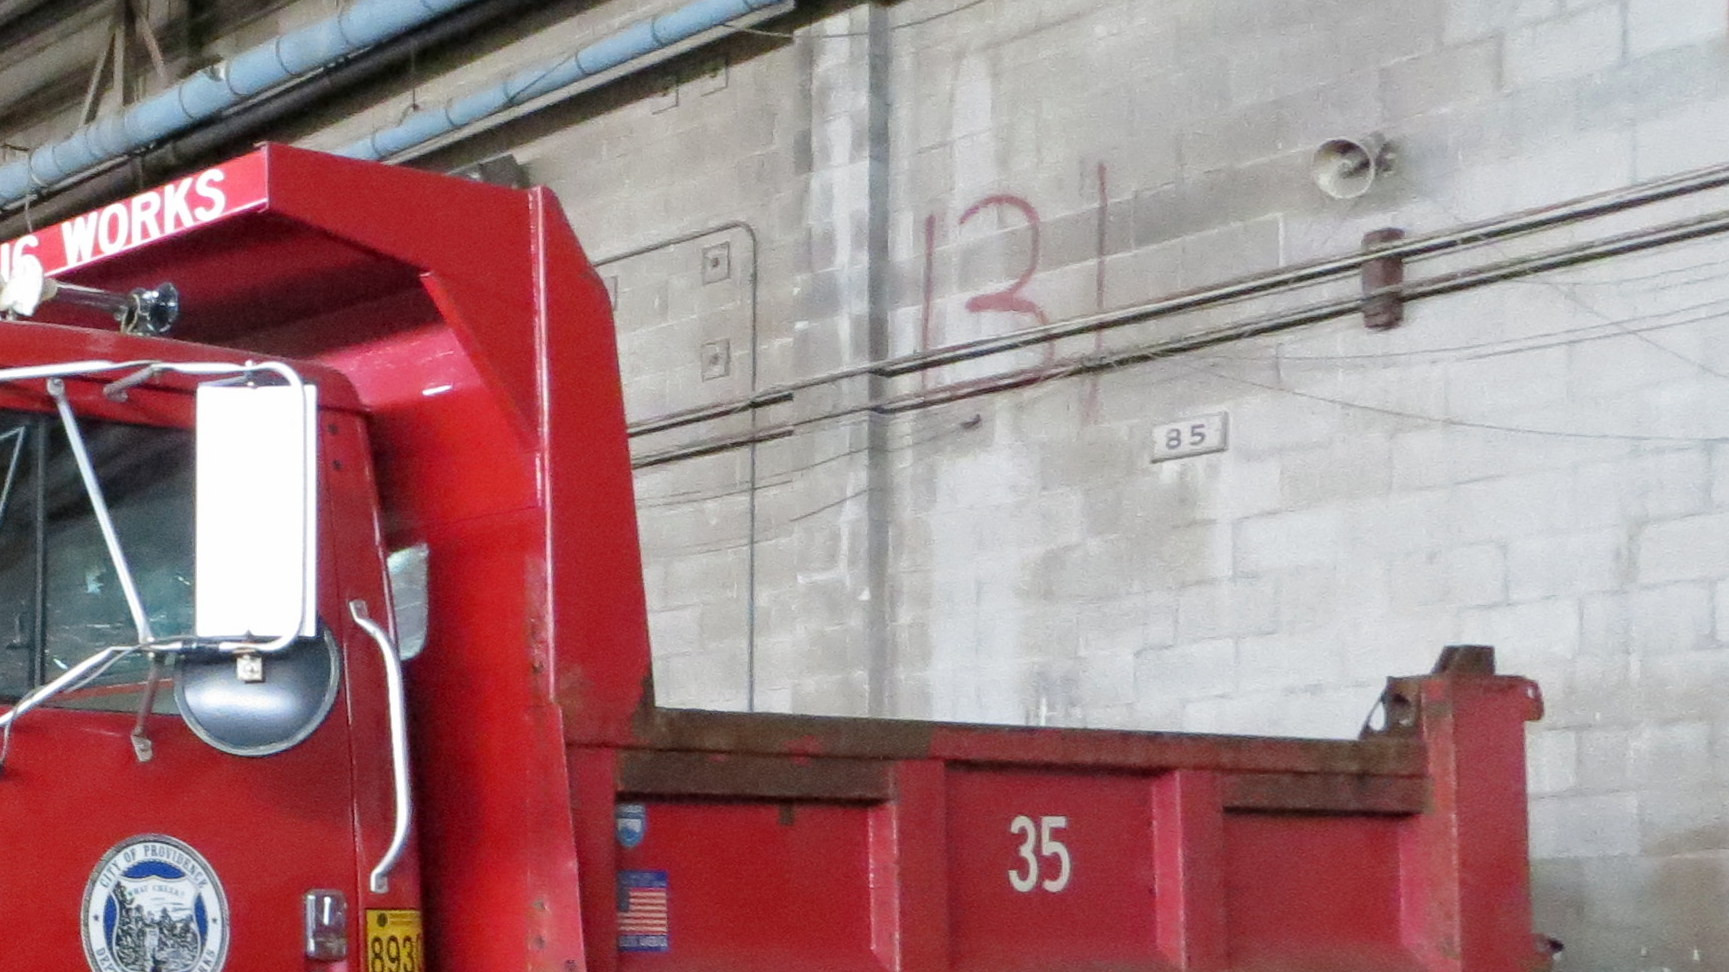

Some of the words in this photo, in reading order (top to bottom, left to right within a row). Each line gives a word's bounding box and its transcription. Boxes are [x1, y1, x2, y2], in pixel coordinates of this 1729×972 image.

[62, 168, 226, 264] WORKS
[1165, 423, 1206, 450] 85
[99, 861, 122, 889] CITY
[123, 847, 138, 864] OF
[143, 844, 209, 889] PROVIDENCE
[1008, 814, 1071, 893] 35
